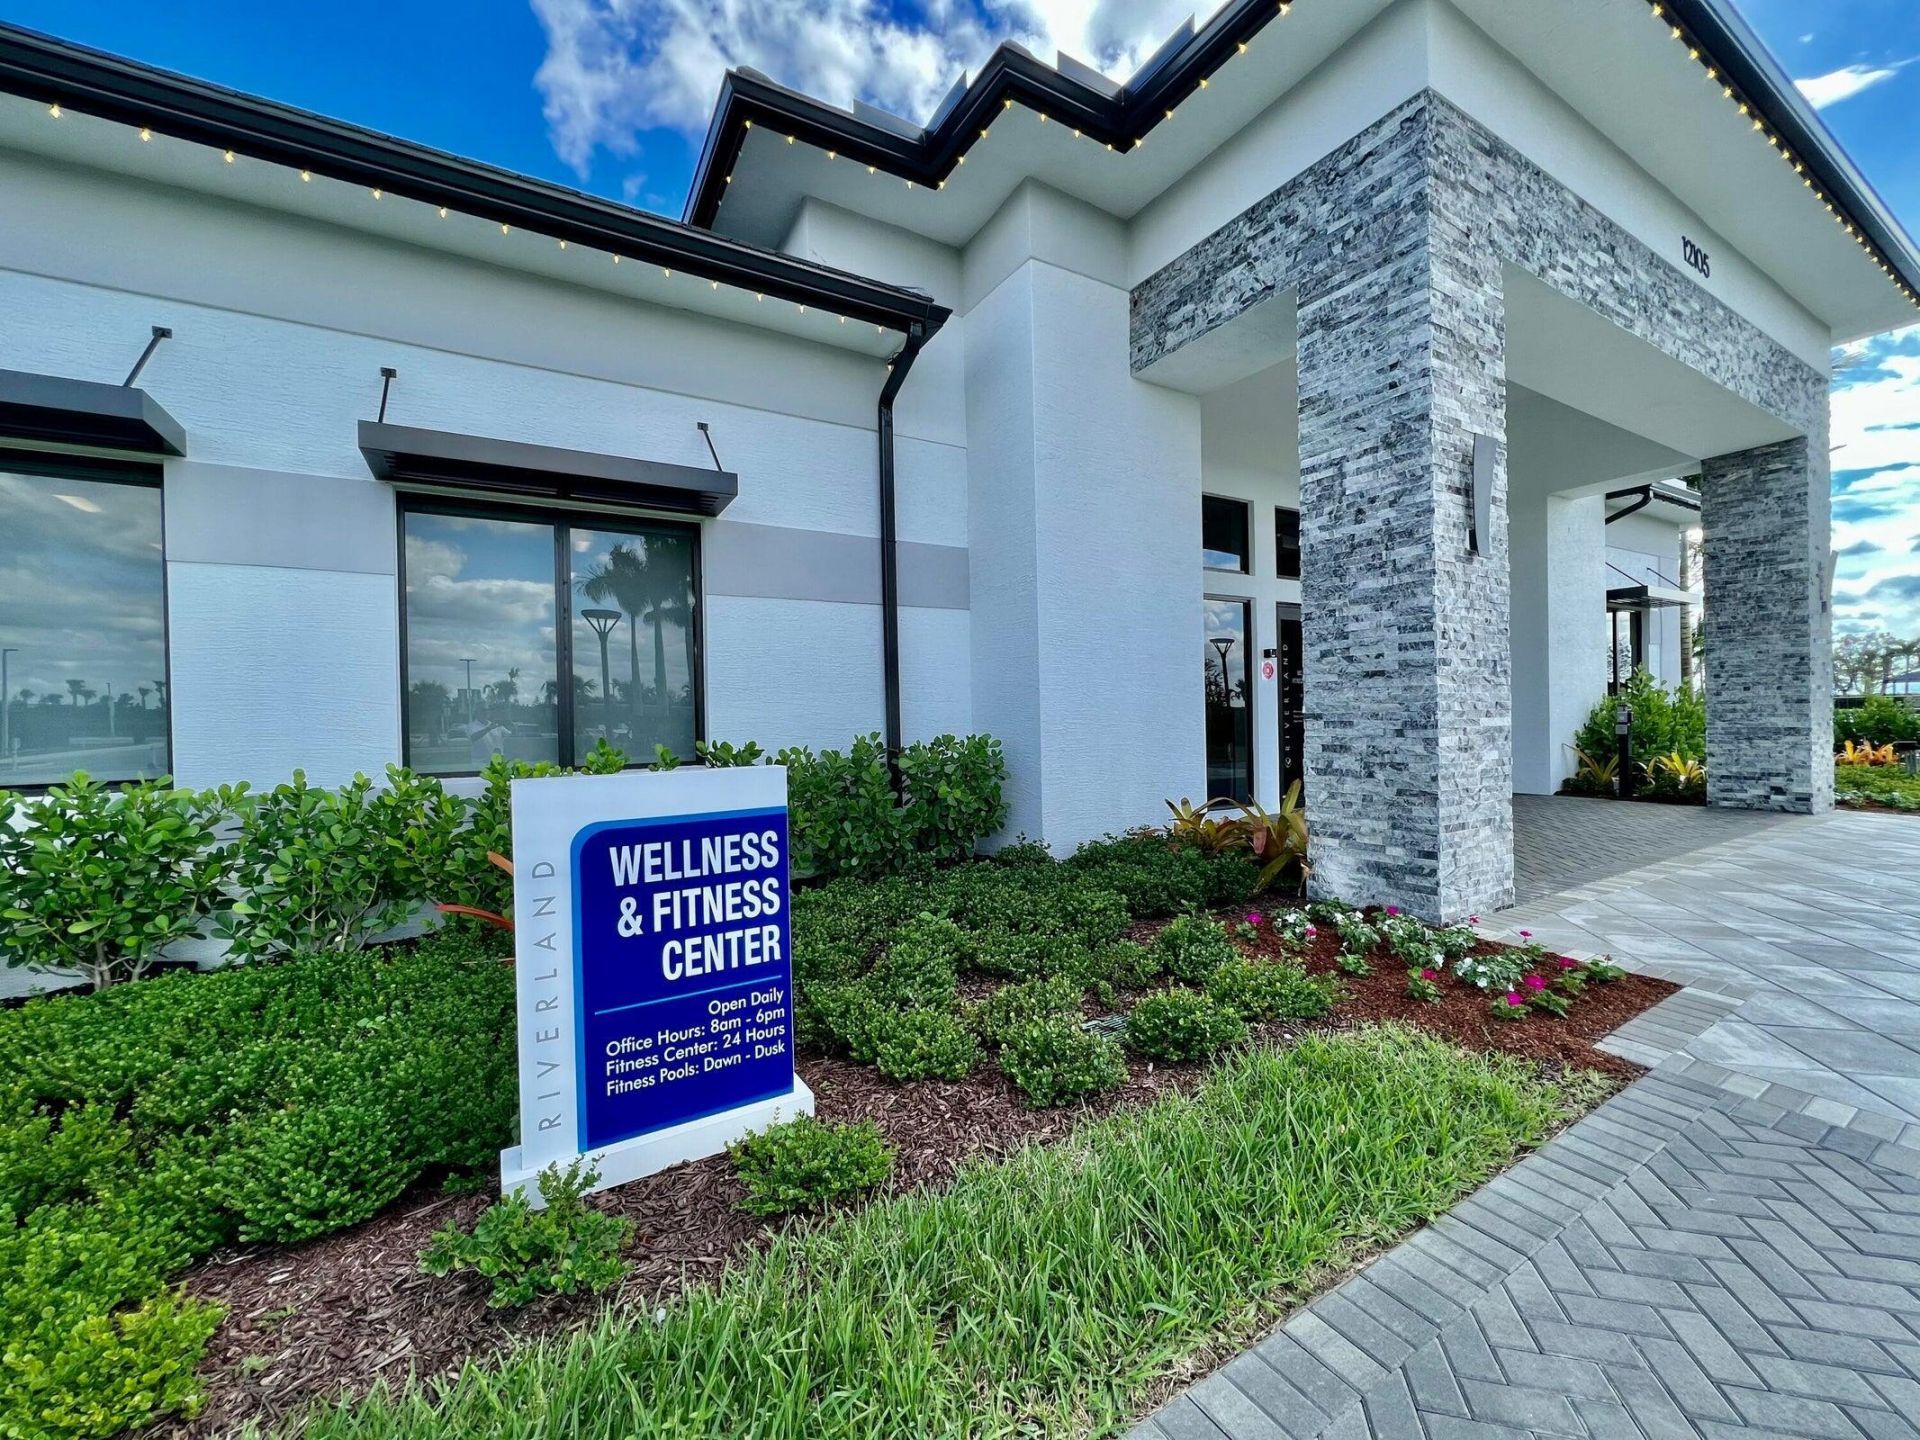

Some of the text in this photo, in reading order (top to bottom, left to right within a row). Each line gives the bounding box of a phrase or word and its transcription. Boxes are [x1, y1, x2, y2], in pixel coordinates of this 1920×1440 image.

[1682, 235, 1709, 278] 12105
[609, 830, 779, 887] WELLNESS
[617, 877, 781, 938] & FITNESS
[662, 924, 781, 981] CENTER
[532, 861, 561, 1132] RIVERLAND
[708, 987, 784, 1016] Open Daily
[605, 1036, 653, 1057] Office
[657, 1025, 705, 1046] Hours:
[710, 1017, 741, 1034] 8am
[756, 1007, 785, 1025] 6pm
[606, 1024, 785, 1077] Fitness Center: 24 Hours
[606, 1073, 655, 1096] Fitness
[660, 1062, 699, 1083] Pools:
[704, 1053, 741, 1072] Dawn
[754, 1039, 785, 1059] Dusk
